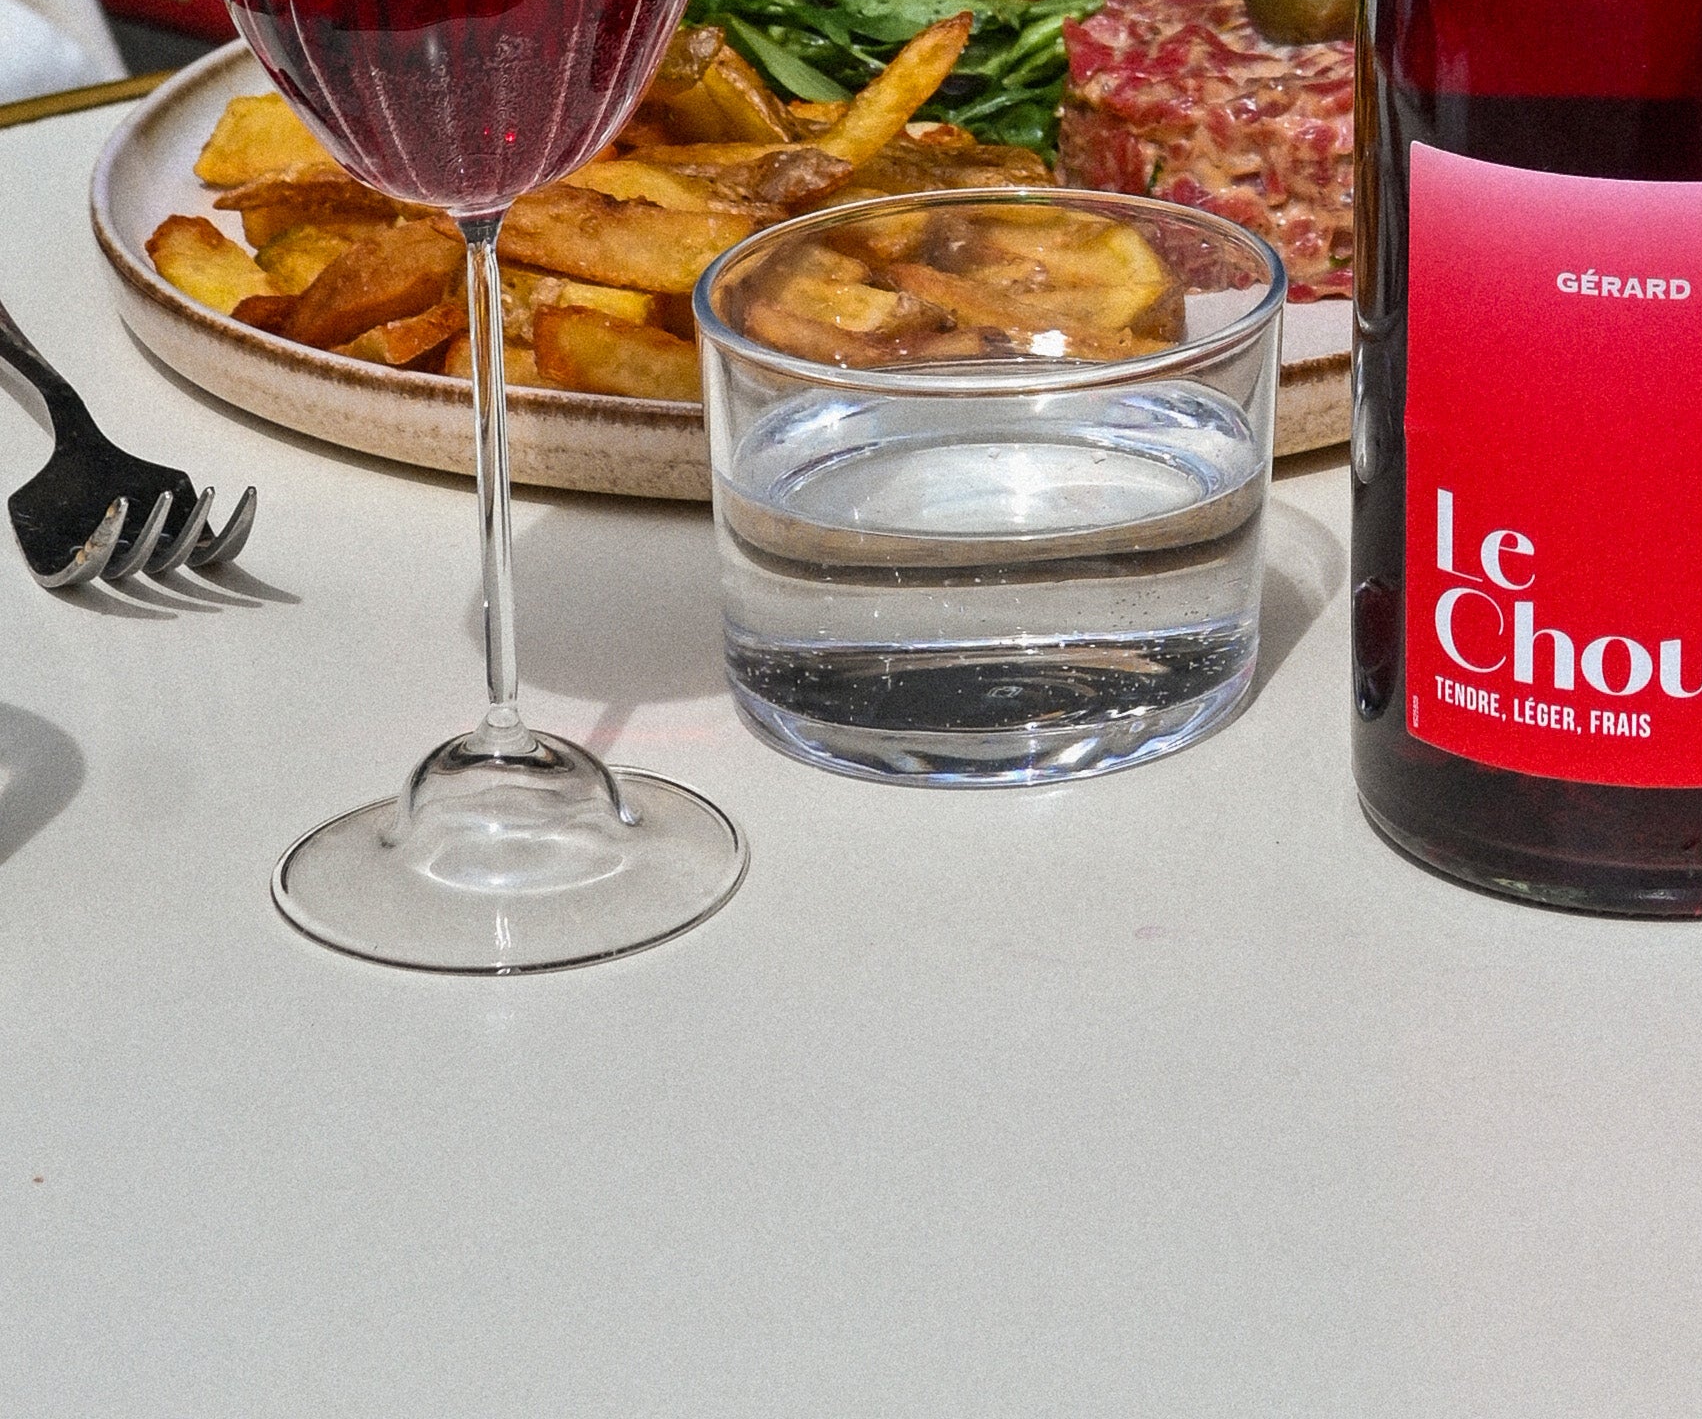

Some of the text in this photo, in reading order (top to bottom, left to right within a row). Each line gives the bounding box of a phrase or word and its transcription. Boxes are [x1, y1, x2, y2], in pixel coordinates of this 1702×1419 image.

[1556, 269, 1692, 300] GÉRARD
[1437, 488, 1536, 591] Le
[1435, 675, 1506, 722] TENDRE,
[1513, 696, 1582, 735] LÉGER,
[1589, 710, 1651, 738] FRAIS
